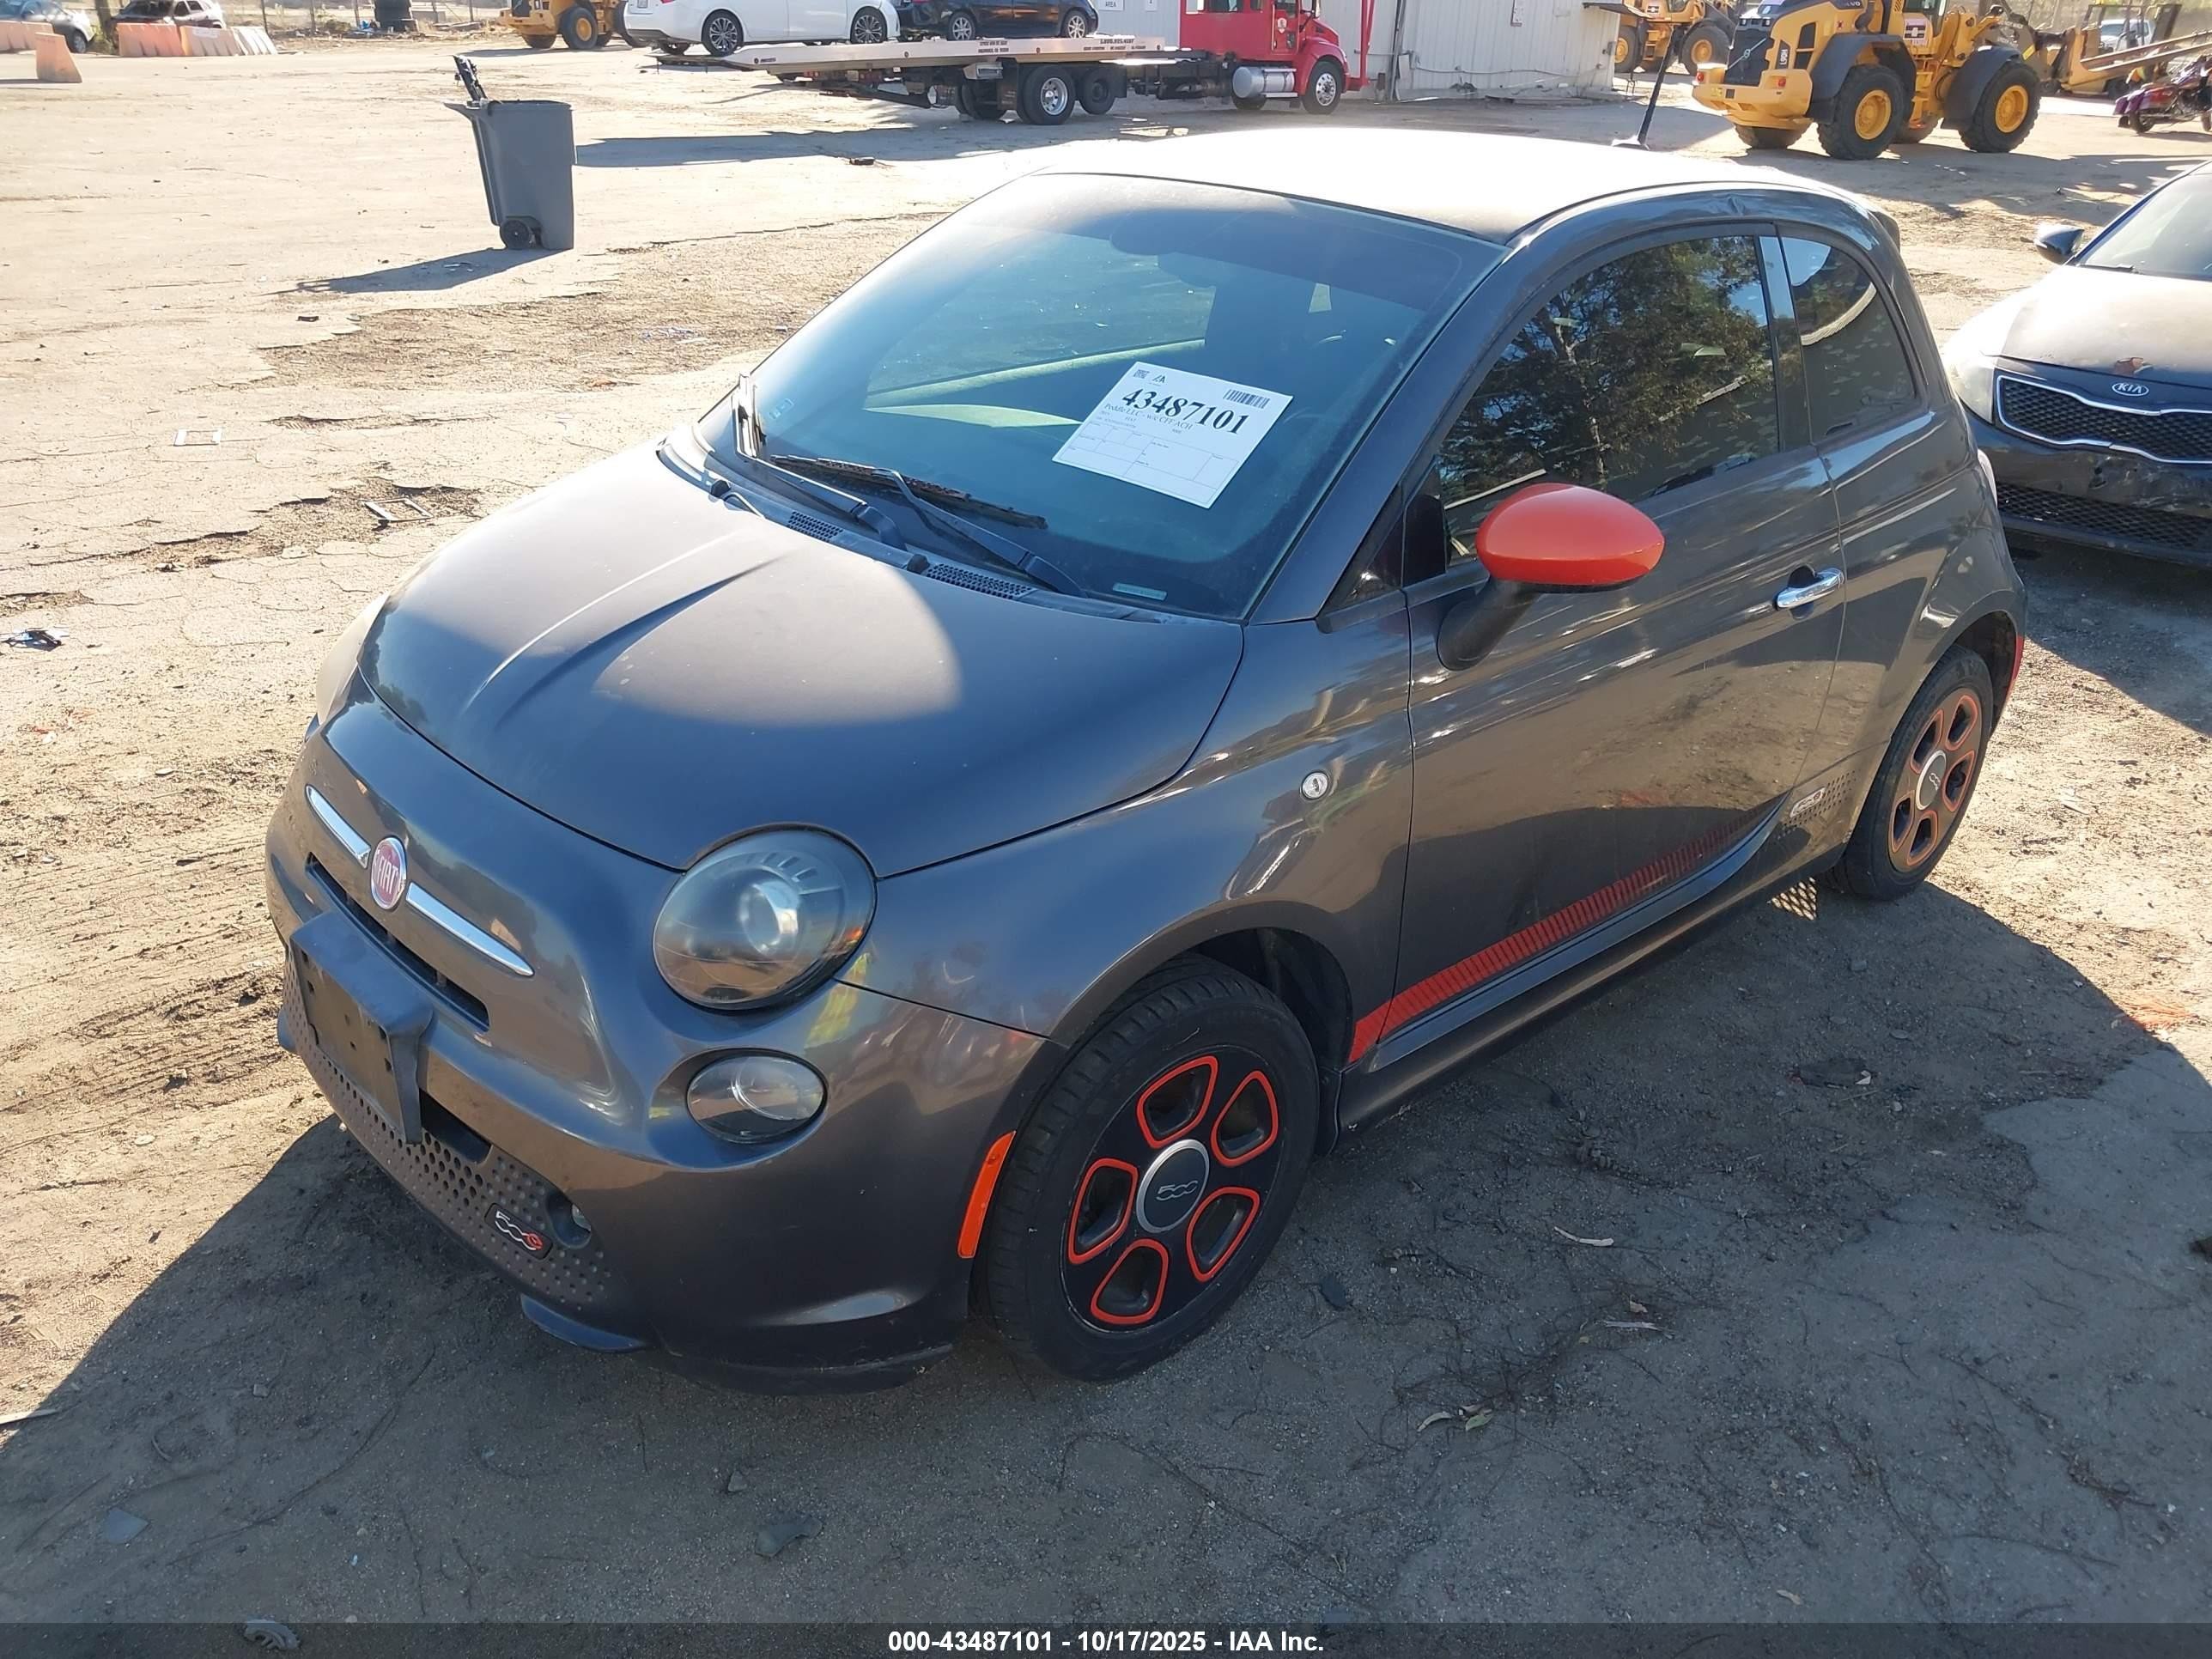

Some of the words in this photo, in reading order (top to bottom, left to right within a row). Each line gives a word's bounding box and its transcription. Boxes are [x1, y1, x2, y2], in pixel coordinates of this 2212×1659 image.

[2117, 382, 2142, 394] KIA
[1121, 388, 1250, 434] 43487101
[377, 855, 399, 895] FIAT
[1156, 1180, 1199, 1201] 500
